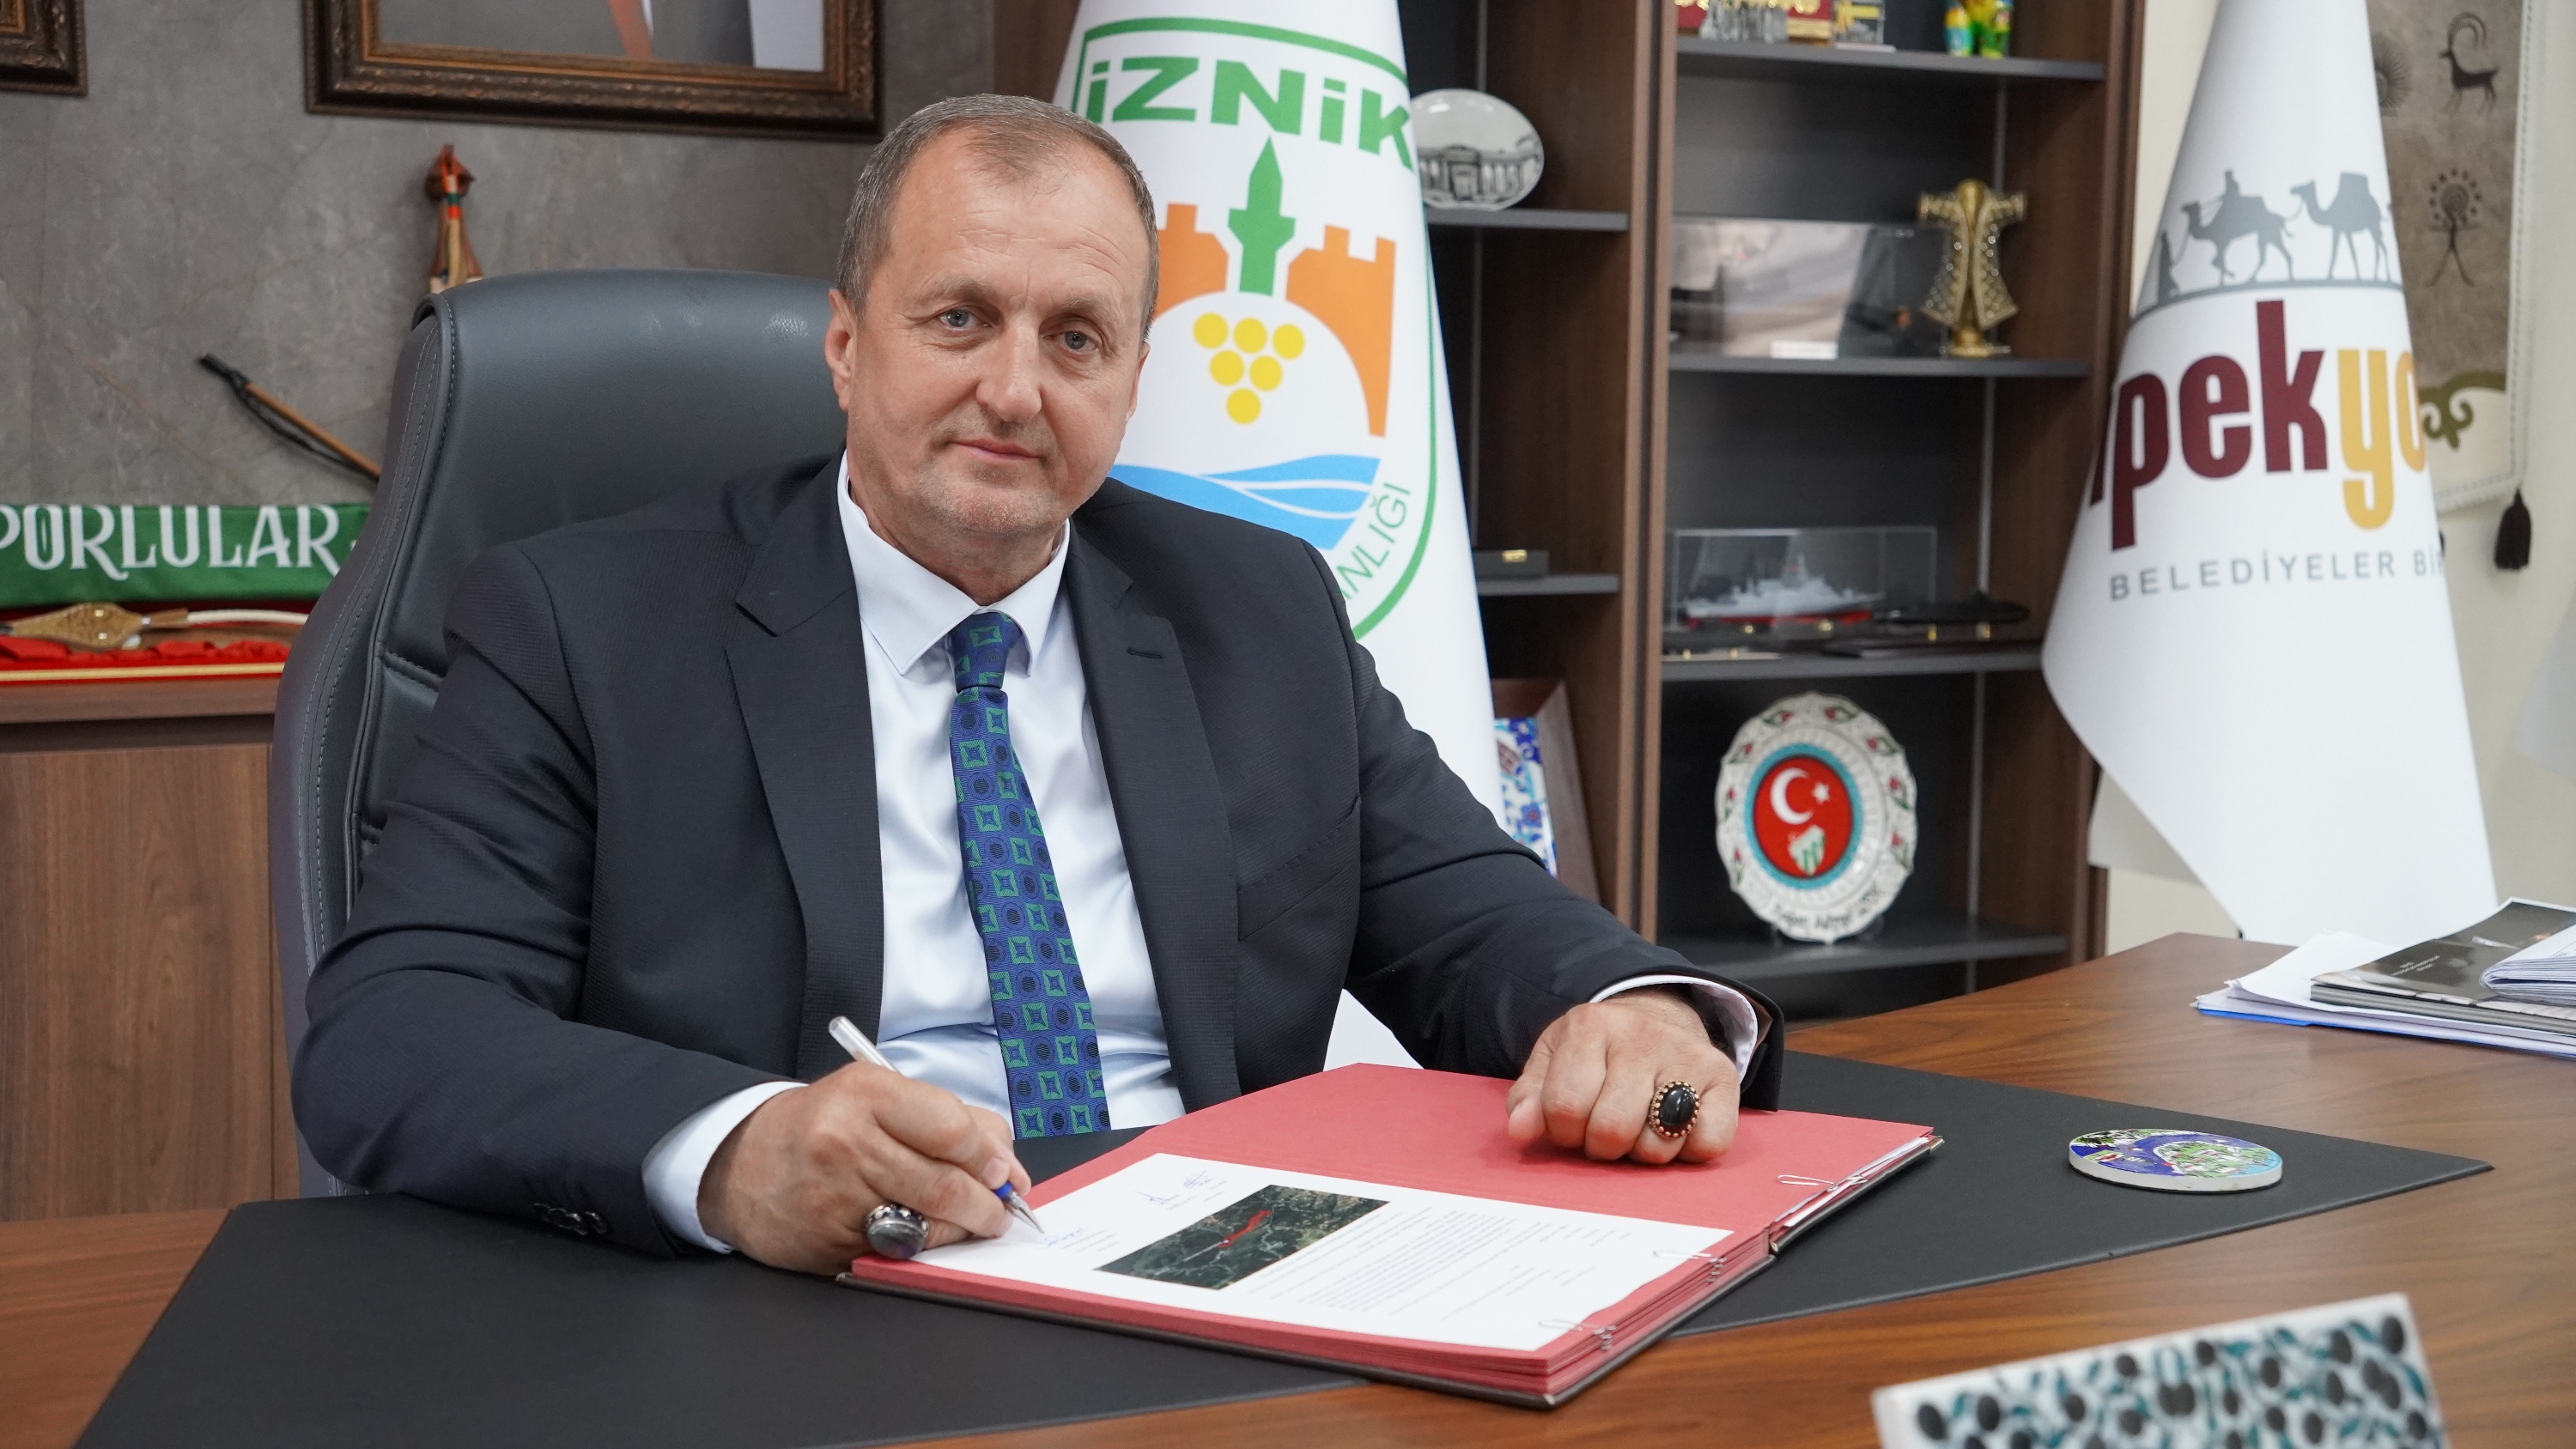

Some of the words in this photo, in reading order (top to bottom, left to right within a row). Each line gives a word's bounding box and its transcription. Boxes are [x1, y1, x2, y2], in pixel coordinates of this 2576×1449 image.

[2090, 300, 2425, 552] pekyo
[1337, 482, 1411, 600] NLIĞI
[2109, 548, 2395, 601] BELEDİYELER
